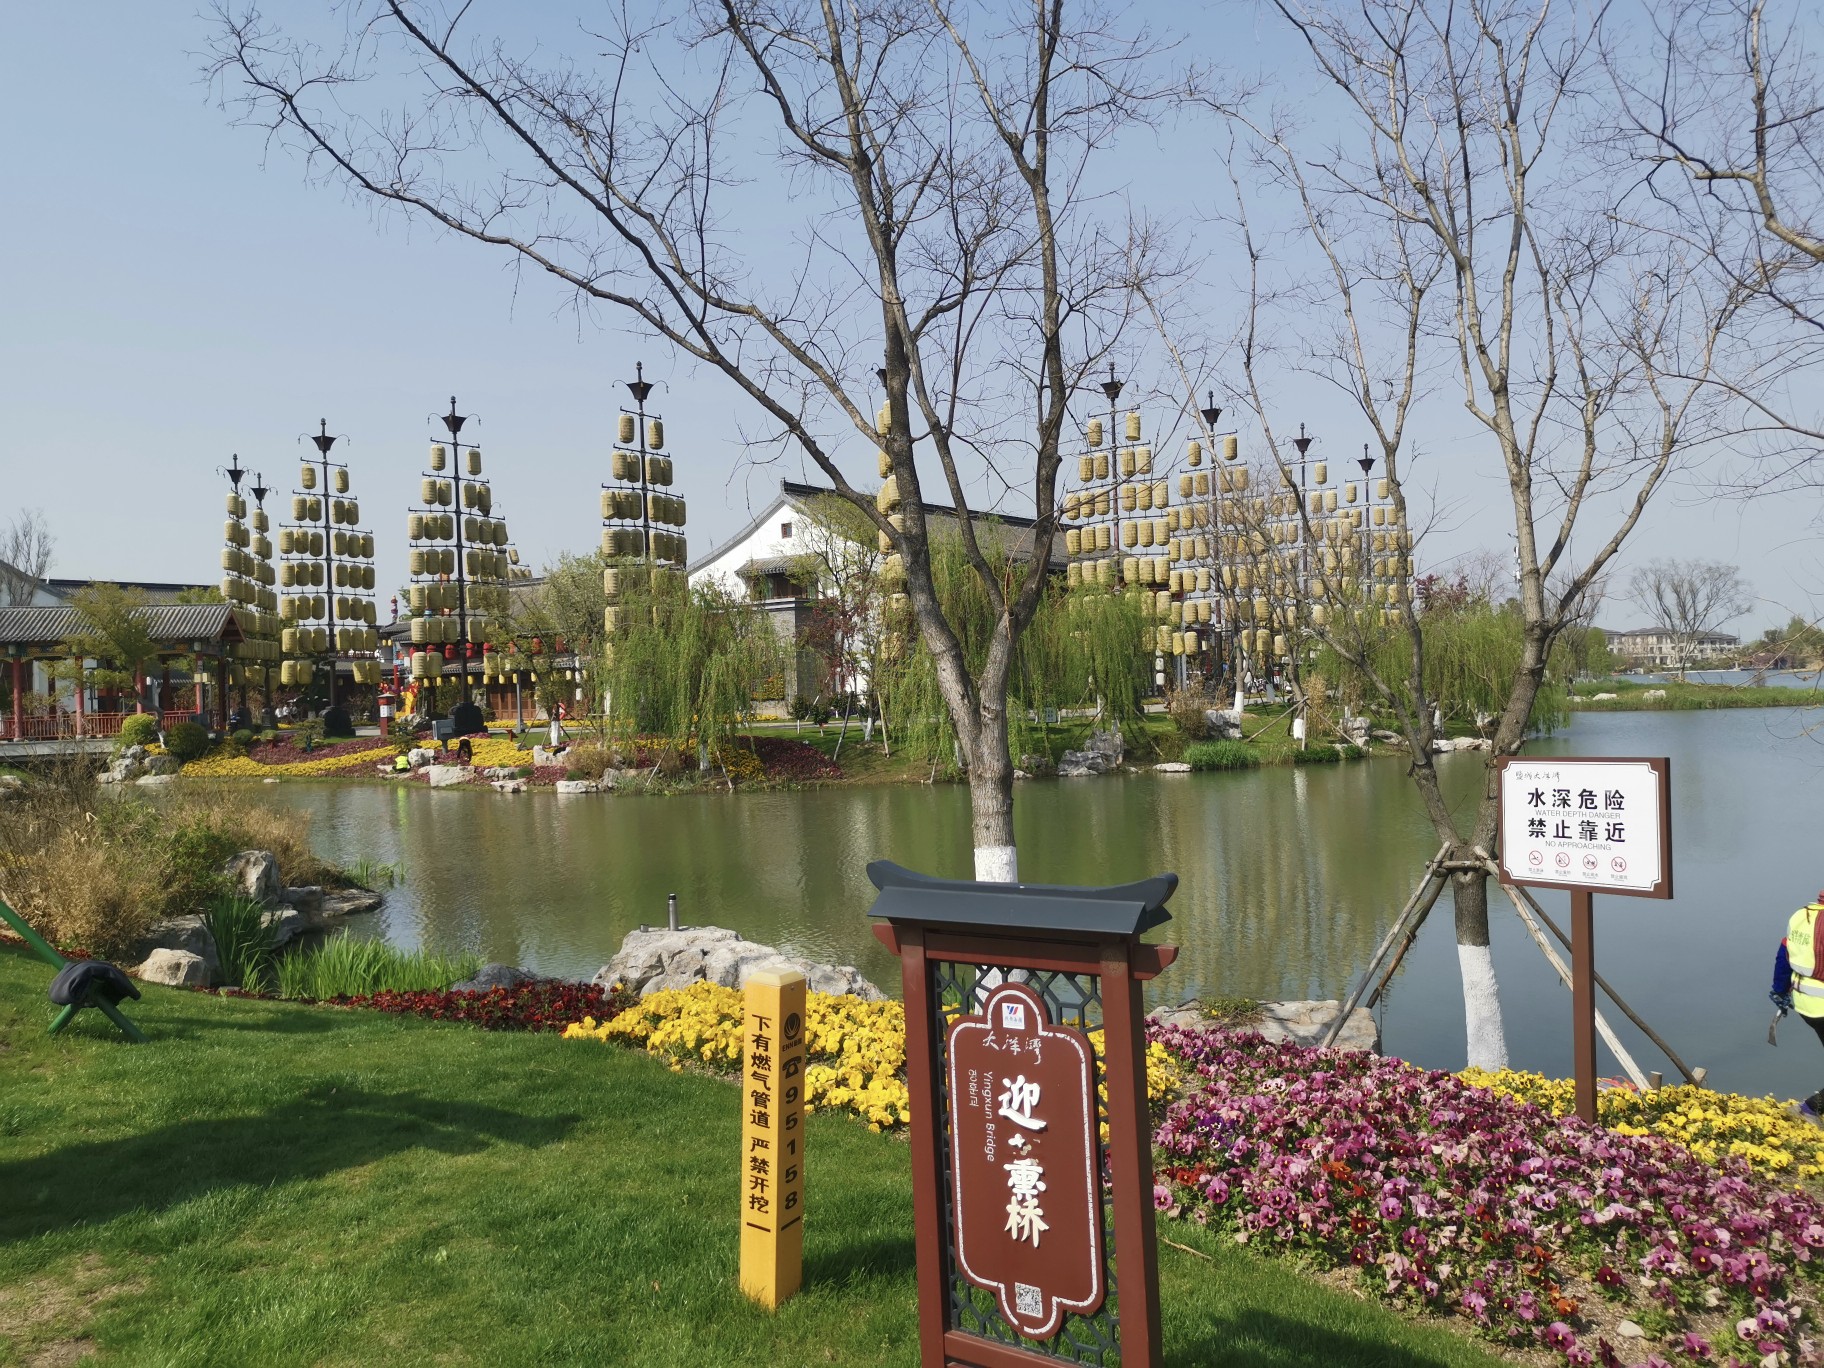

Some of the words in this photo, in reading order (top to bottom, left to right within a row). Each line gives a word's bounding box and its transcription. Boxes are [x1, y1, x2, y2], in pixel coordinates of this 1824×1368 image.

[1528, 787, 1625, 811] 水深危险
[1535, 809, 1560, 817] WATER
[1528, 818, 1625, 842] 禁止靠近
[1558, 841, 1612, 851] APPROACHING
[750, 1014, 772, 1129] 下有燃气管道
[981, 1071, 993, 1119] Yingxun
[784, 1086, 799, 1210] 95158
[984, 1123, 996, 1162] Bridge
[749, 1136, 771, 1214] 严禁开挖
